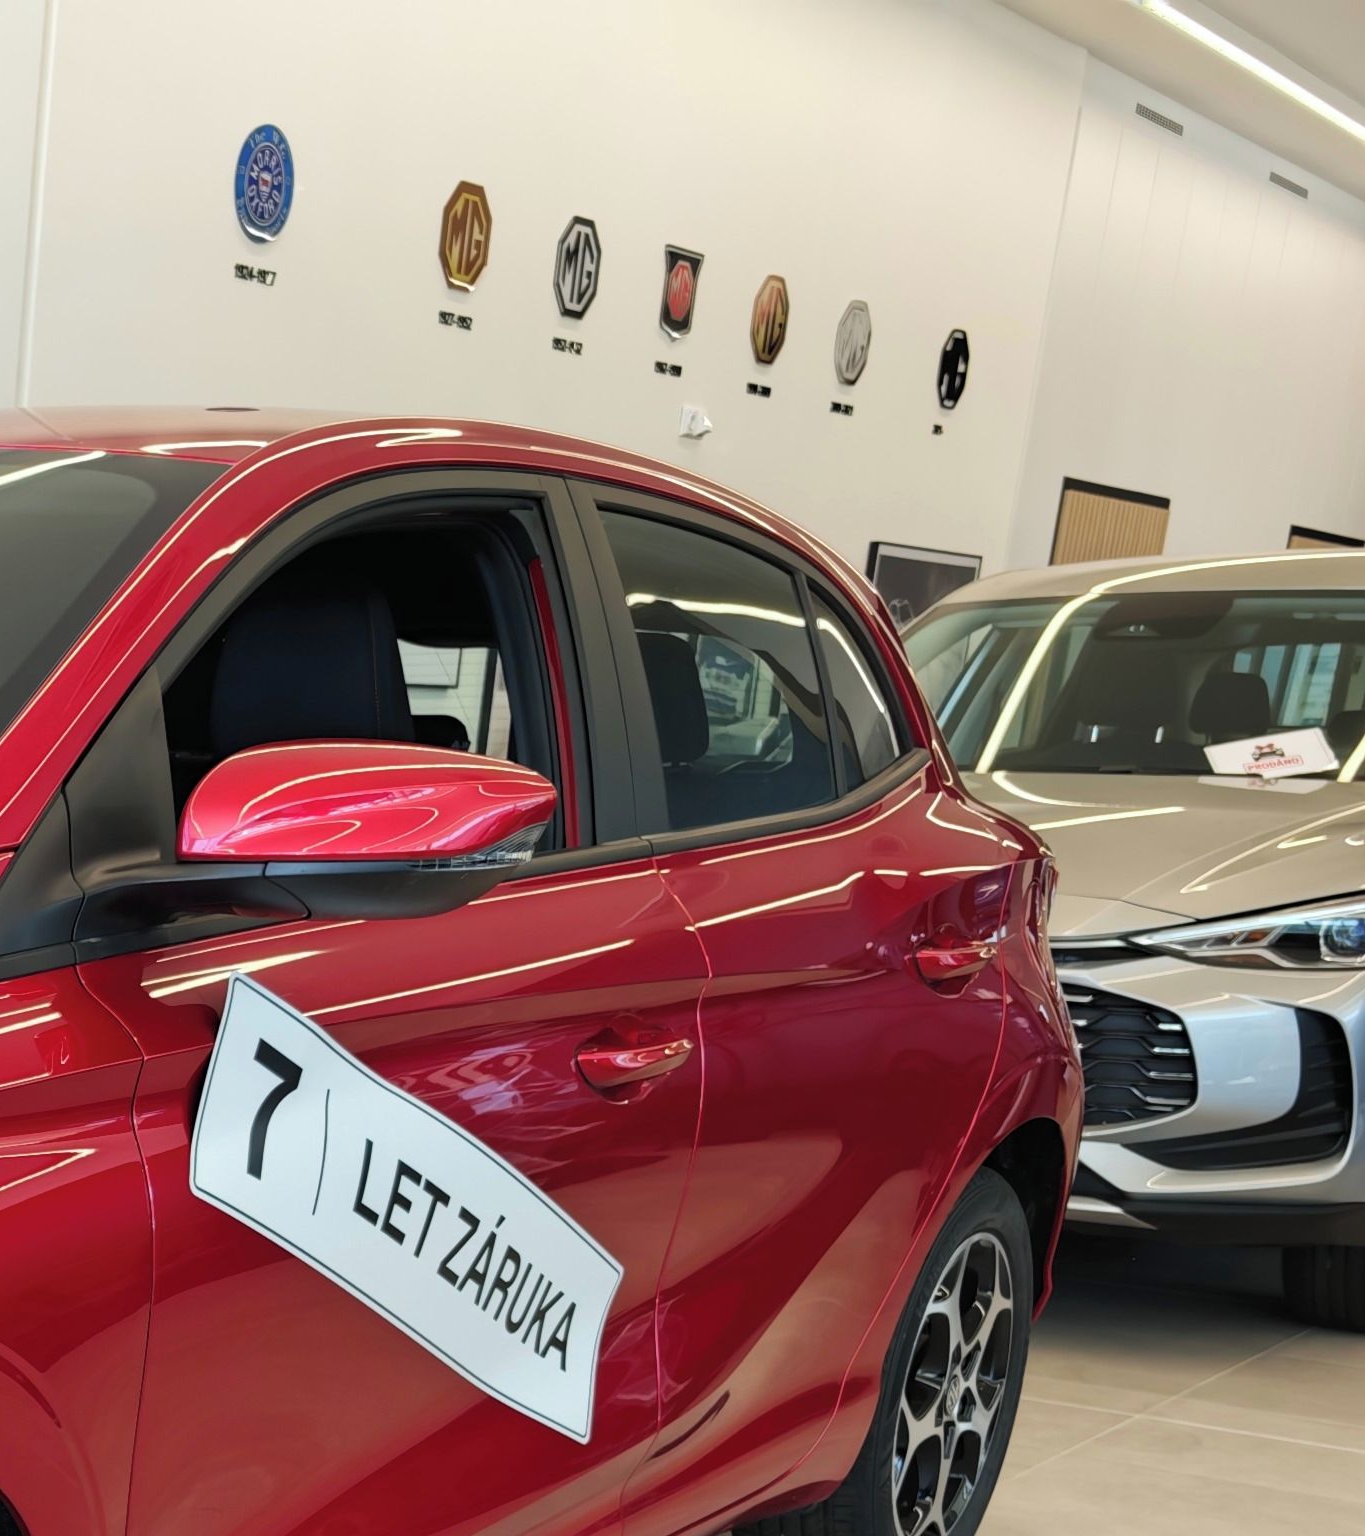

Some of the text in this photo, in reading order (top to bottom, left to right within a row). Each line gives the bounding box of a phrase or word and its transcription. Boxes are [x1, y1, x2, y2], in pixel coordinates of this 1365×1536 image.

[247, 185, 281, 219] OXFORD
[249, 149, 283, 186] MORRIS
[446, 193, 485, 280] MG
[561, 224, 595, 309] MG
[756, 284, 785, 358] MG
[247, 1037, 577, 1373] 7 LET ZÁRUKA
